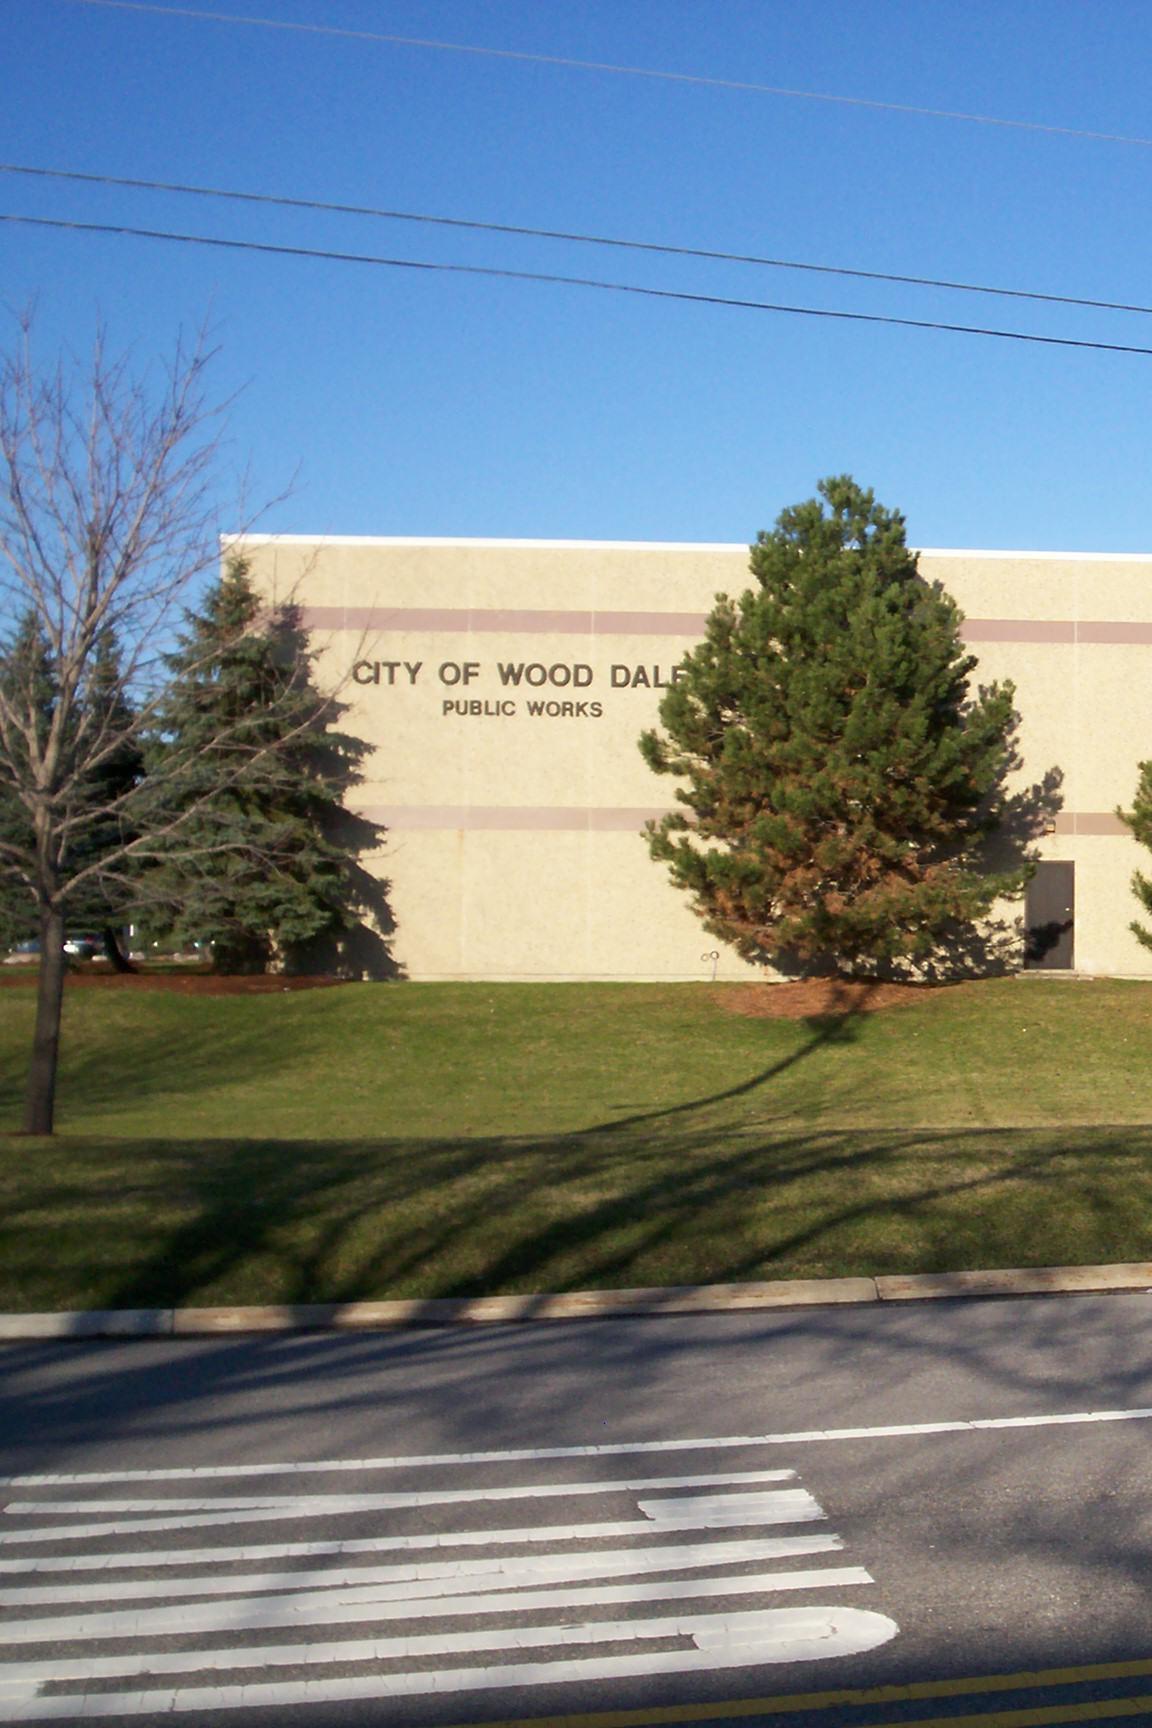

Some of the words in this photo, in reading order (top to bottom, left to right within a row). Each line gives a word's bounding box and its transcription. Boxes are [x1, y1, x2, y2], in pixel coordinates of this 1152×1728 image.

[352, 660, 423, 686] CITY
[438, 661, 481, 686] OF
[497, 662, 593, 688] WOOD
[442, 700, 516, 716] PUBLIC
[527, 701, 603, 718] WORKS
